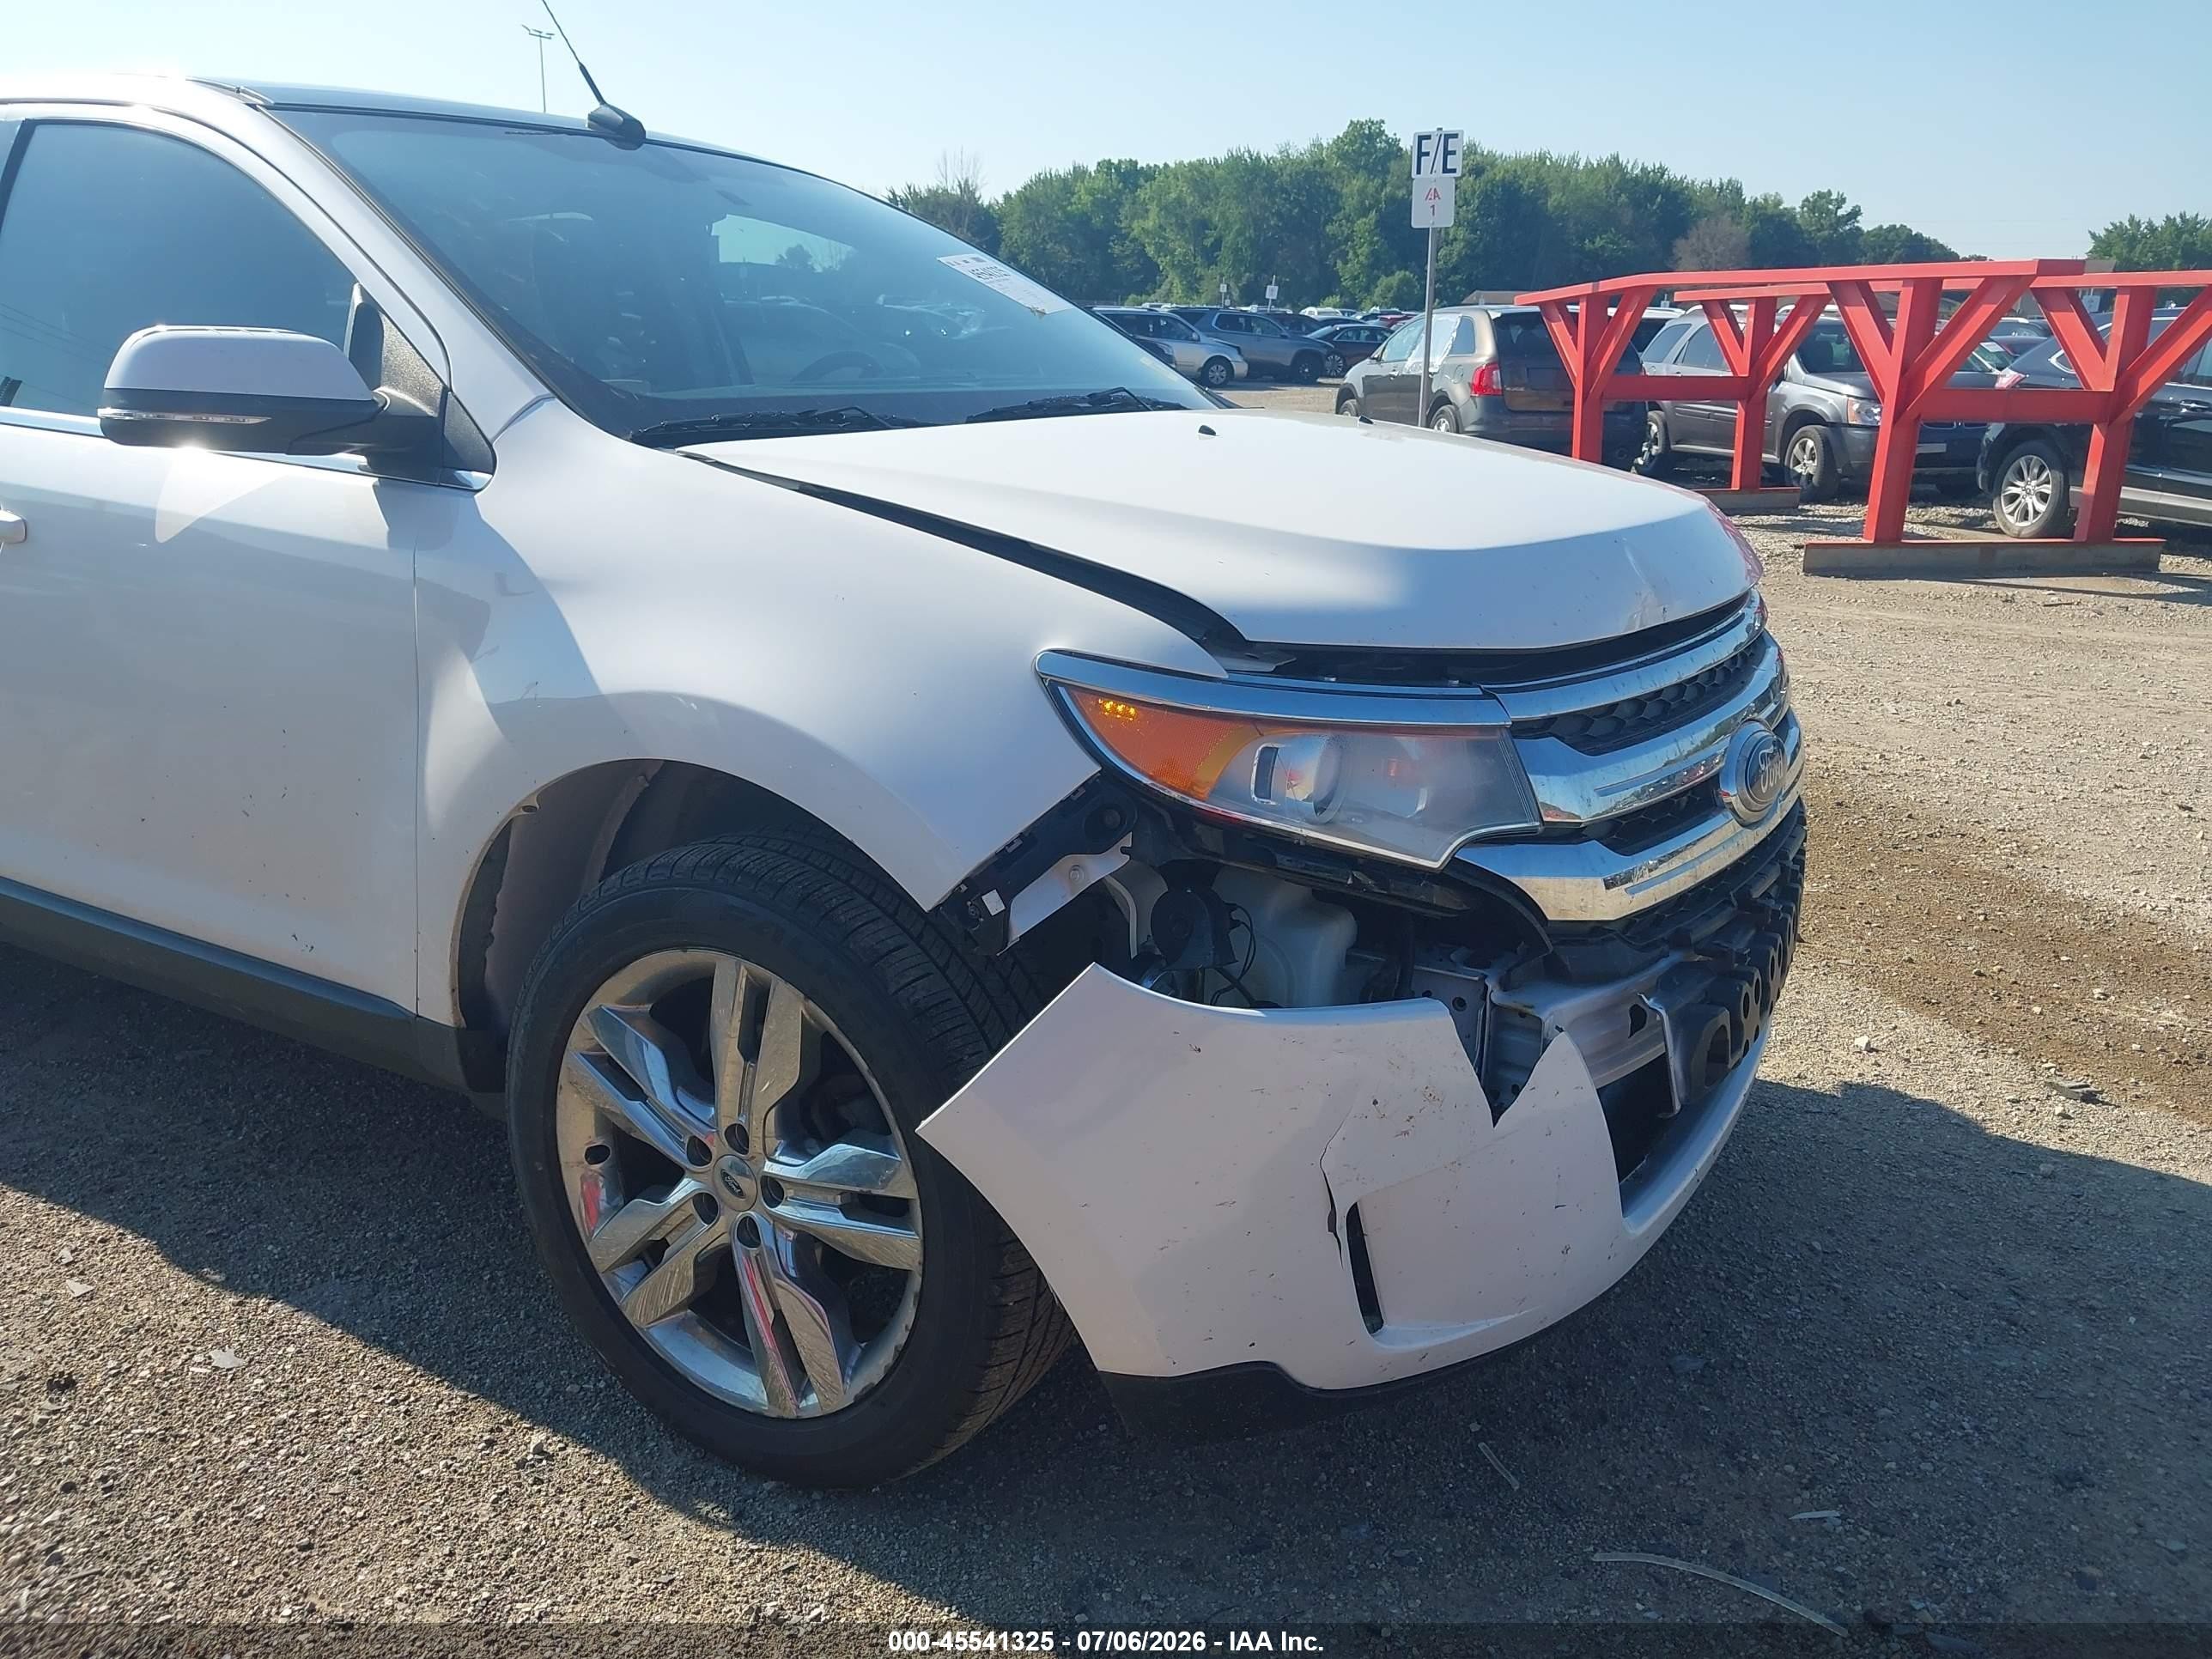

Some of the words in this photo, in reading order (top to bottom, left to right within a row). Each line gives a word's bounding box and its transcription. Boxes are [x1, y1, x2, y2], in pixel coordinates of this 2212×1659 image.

[1416, 133, 1459, 174] F/E
[1430, 204, 1436, 216] 1
[1759, 745, 1783, 793] Ford
[724, 1176, 741, 1194] Ford
